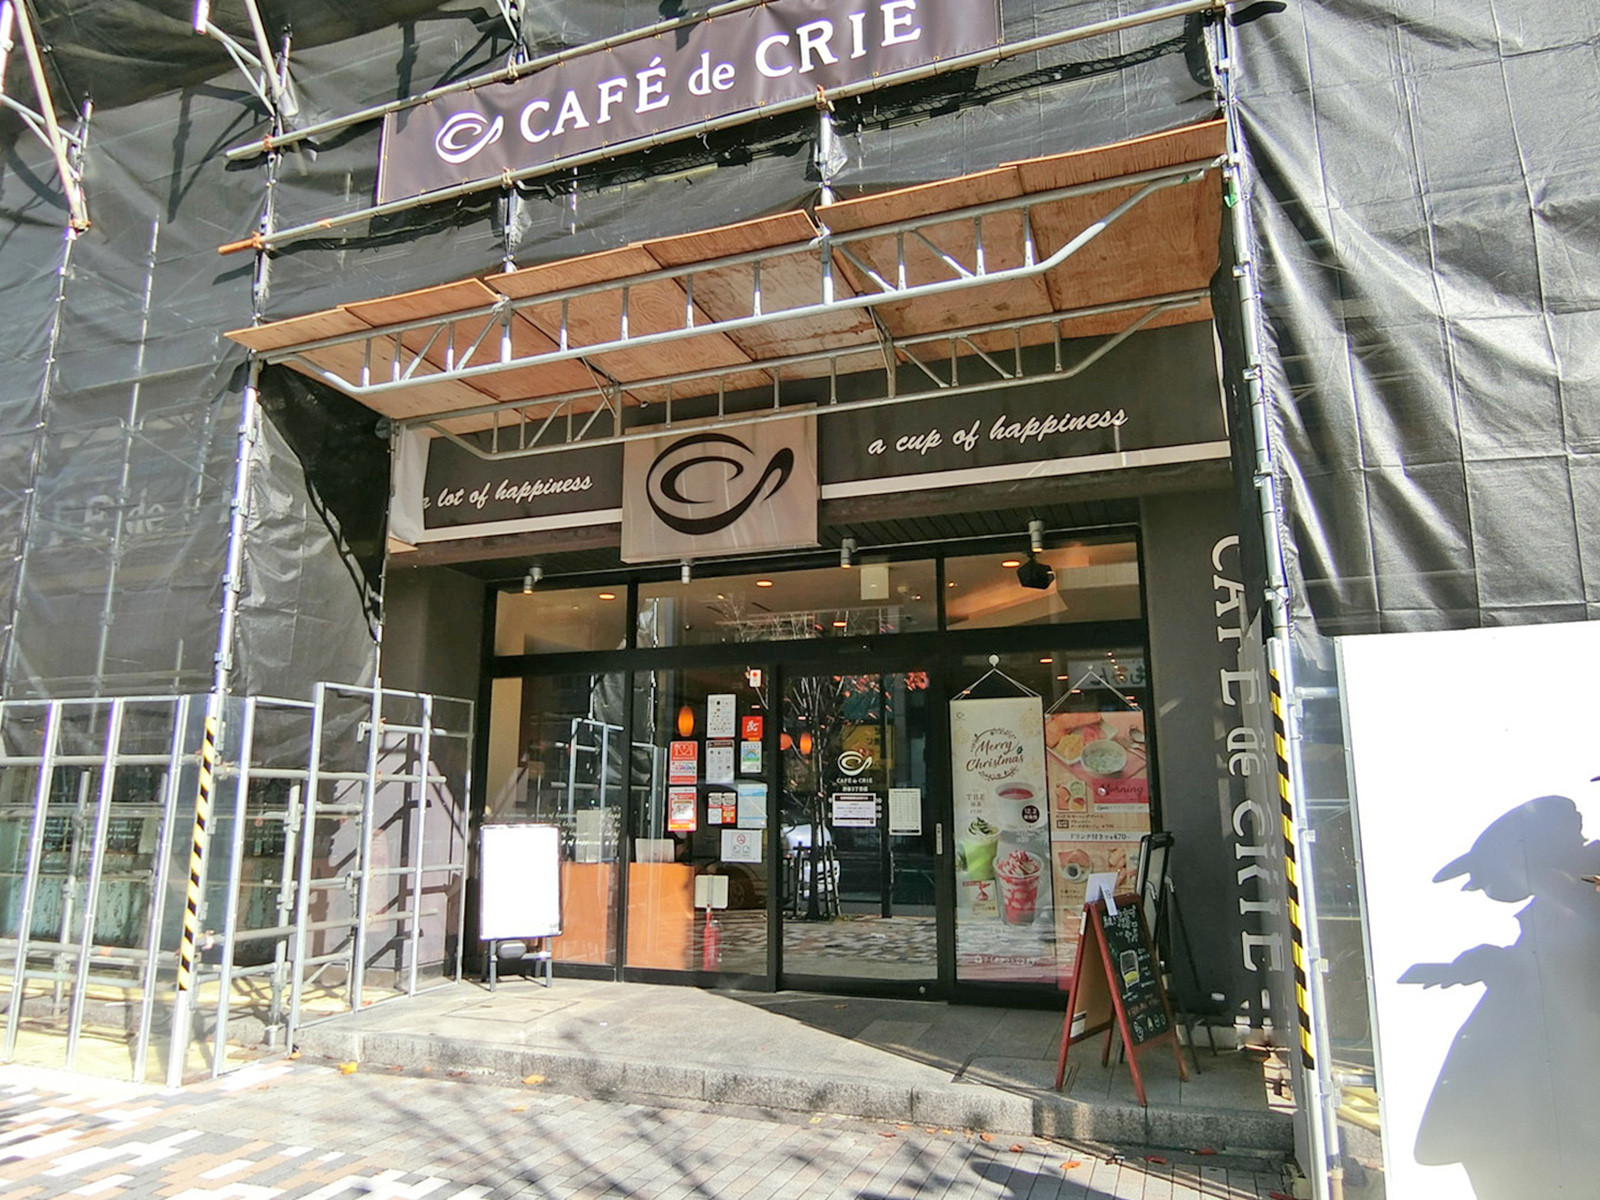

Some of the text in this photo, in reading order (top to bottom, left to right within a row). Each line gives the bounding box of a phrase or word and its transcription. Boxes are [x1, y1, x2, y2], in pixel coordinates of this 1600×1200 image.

[520, 0, 922, 144] CAFÉ de CRIE
[867, 408, 1129, 456] a cup of happiness
[437, 486, 464, 509] lot
[468, 483, 490, 511] of
[494, 473, 594, 505] happiness
[966, 754, 1025, 772] Christmas
[975, 739, 1017, 756] Merry
